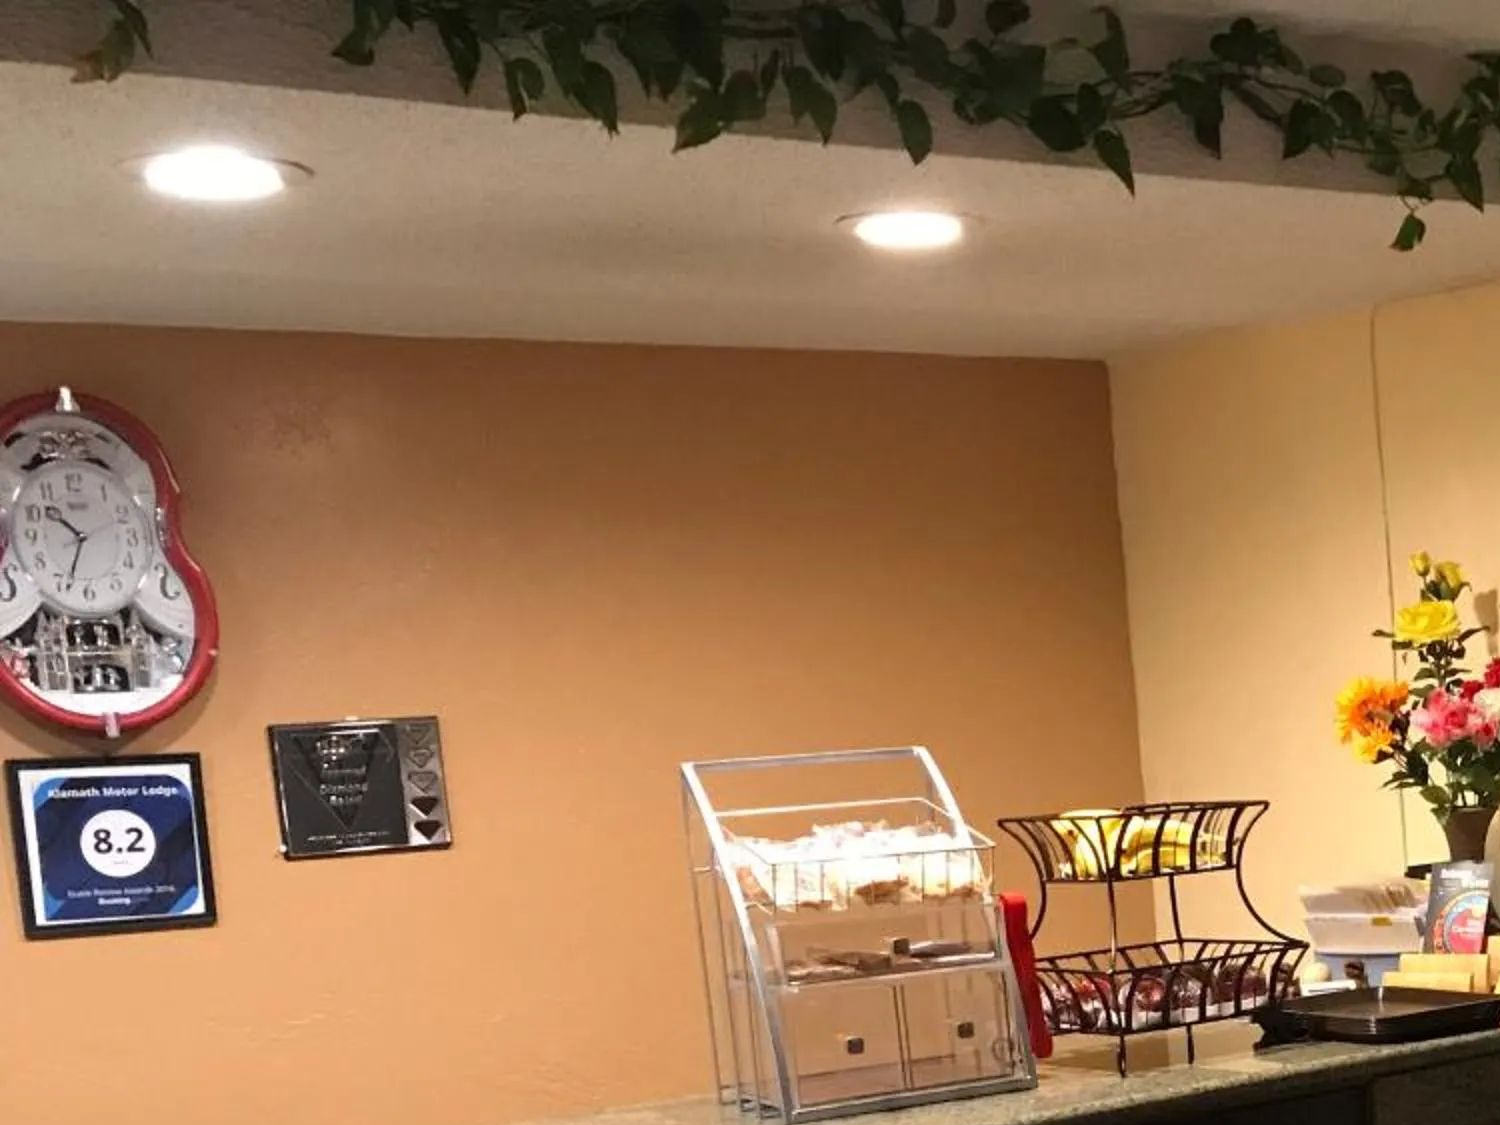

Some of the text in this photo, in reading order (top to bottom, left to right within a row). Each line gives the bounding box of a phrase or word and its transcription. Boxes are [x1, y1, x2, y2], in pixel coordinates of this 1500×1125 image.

[40, 481, 54, 500] 11
[64, 473, 81, 492] 12
[101, 483, 107, 502] 1
[25, 504, 40, 522] 10
[115, 504, 128, 524] 2
[24, 527, 37, 545] 9
[126, 527, 138, 547] 3
[34, 551, 46, 570] 8
[123, 551, 134, 569] 4
[53, 573, 64, 592] 7
[110, 572, 122, 591] 5
[83, 583, 96, 600] 6
[103, 786, 140, 797] Motor
[142, 785, 178, 797] Lodge
[93, 827, 146, 855] 8.2
